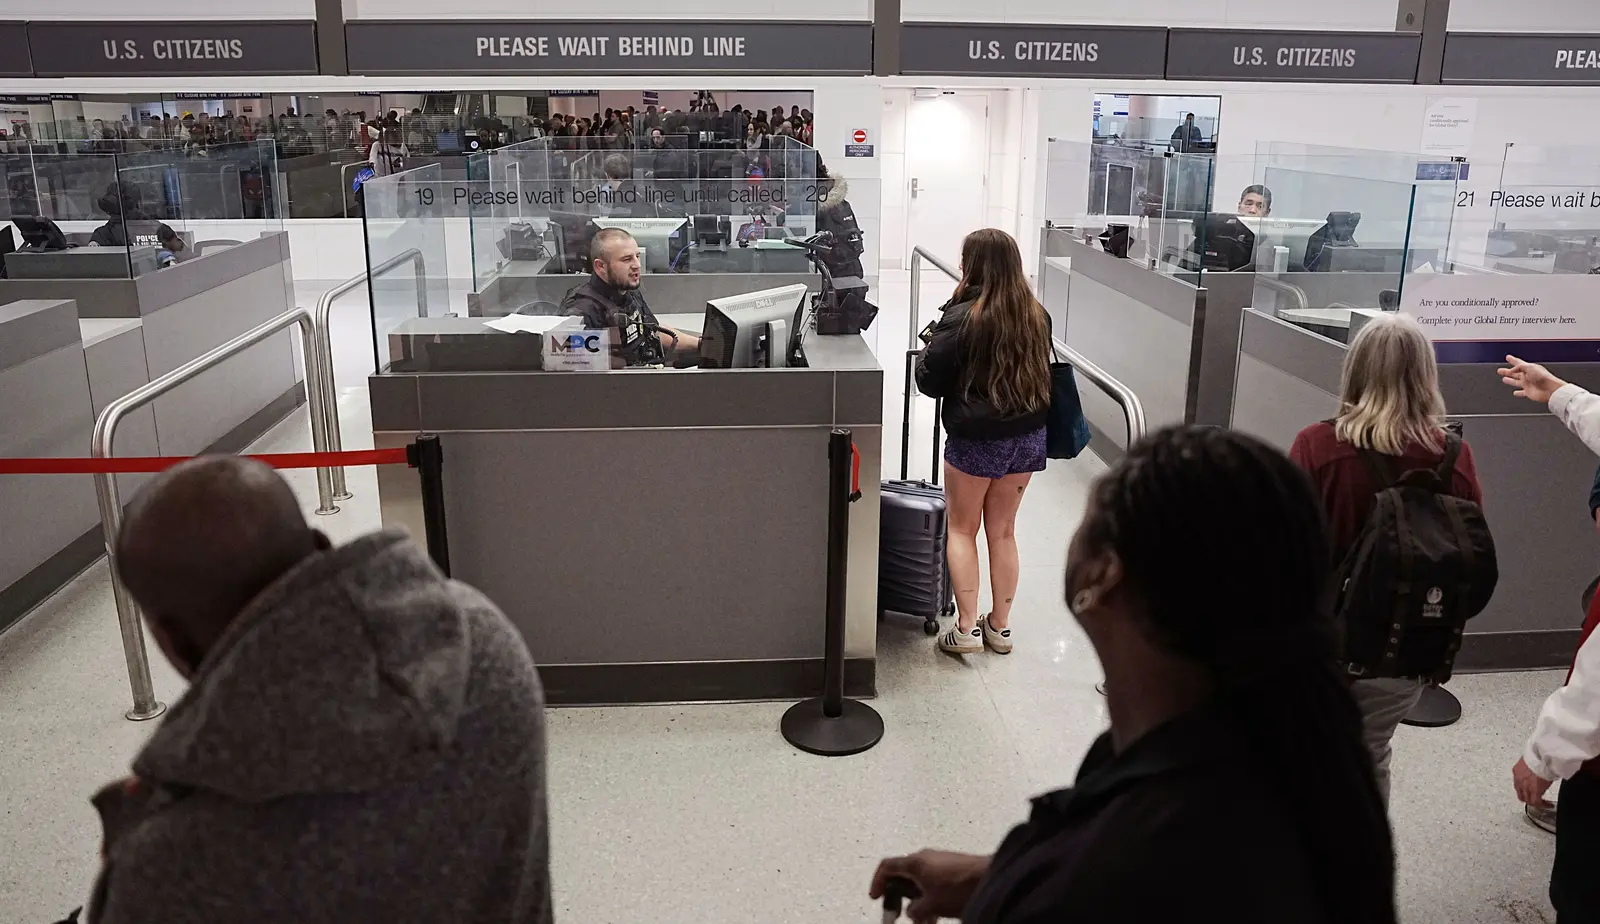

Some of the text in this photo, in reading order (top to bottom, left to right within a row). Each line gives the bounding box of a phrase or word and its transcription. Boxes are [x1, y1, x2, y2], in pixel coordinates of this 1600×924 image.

[103, 39, 243, 60] U.S. CITIZENS
[476, 36, 746, 57] PLEASE WAIT BEHIND LINE
[968, 40, 1099, 62] U.S. CITIZENS
[1233, 46, 1356, 67] U.S. CITIZENS
[414, 185, 828, 206] 19 Please wait behind line until called. 20
[1456, 191, 1475, 207] 21
[1489, 190, 1545, 207] Please
[1551, 191, 1586, 207] wait
[1419, 297, 1539, 309] Are you conditionally approved?
[1417, 315, 1577, 327] Complete your Global Entry interview here.
[551, 335, 600, 353] MPC
